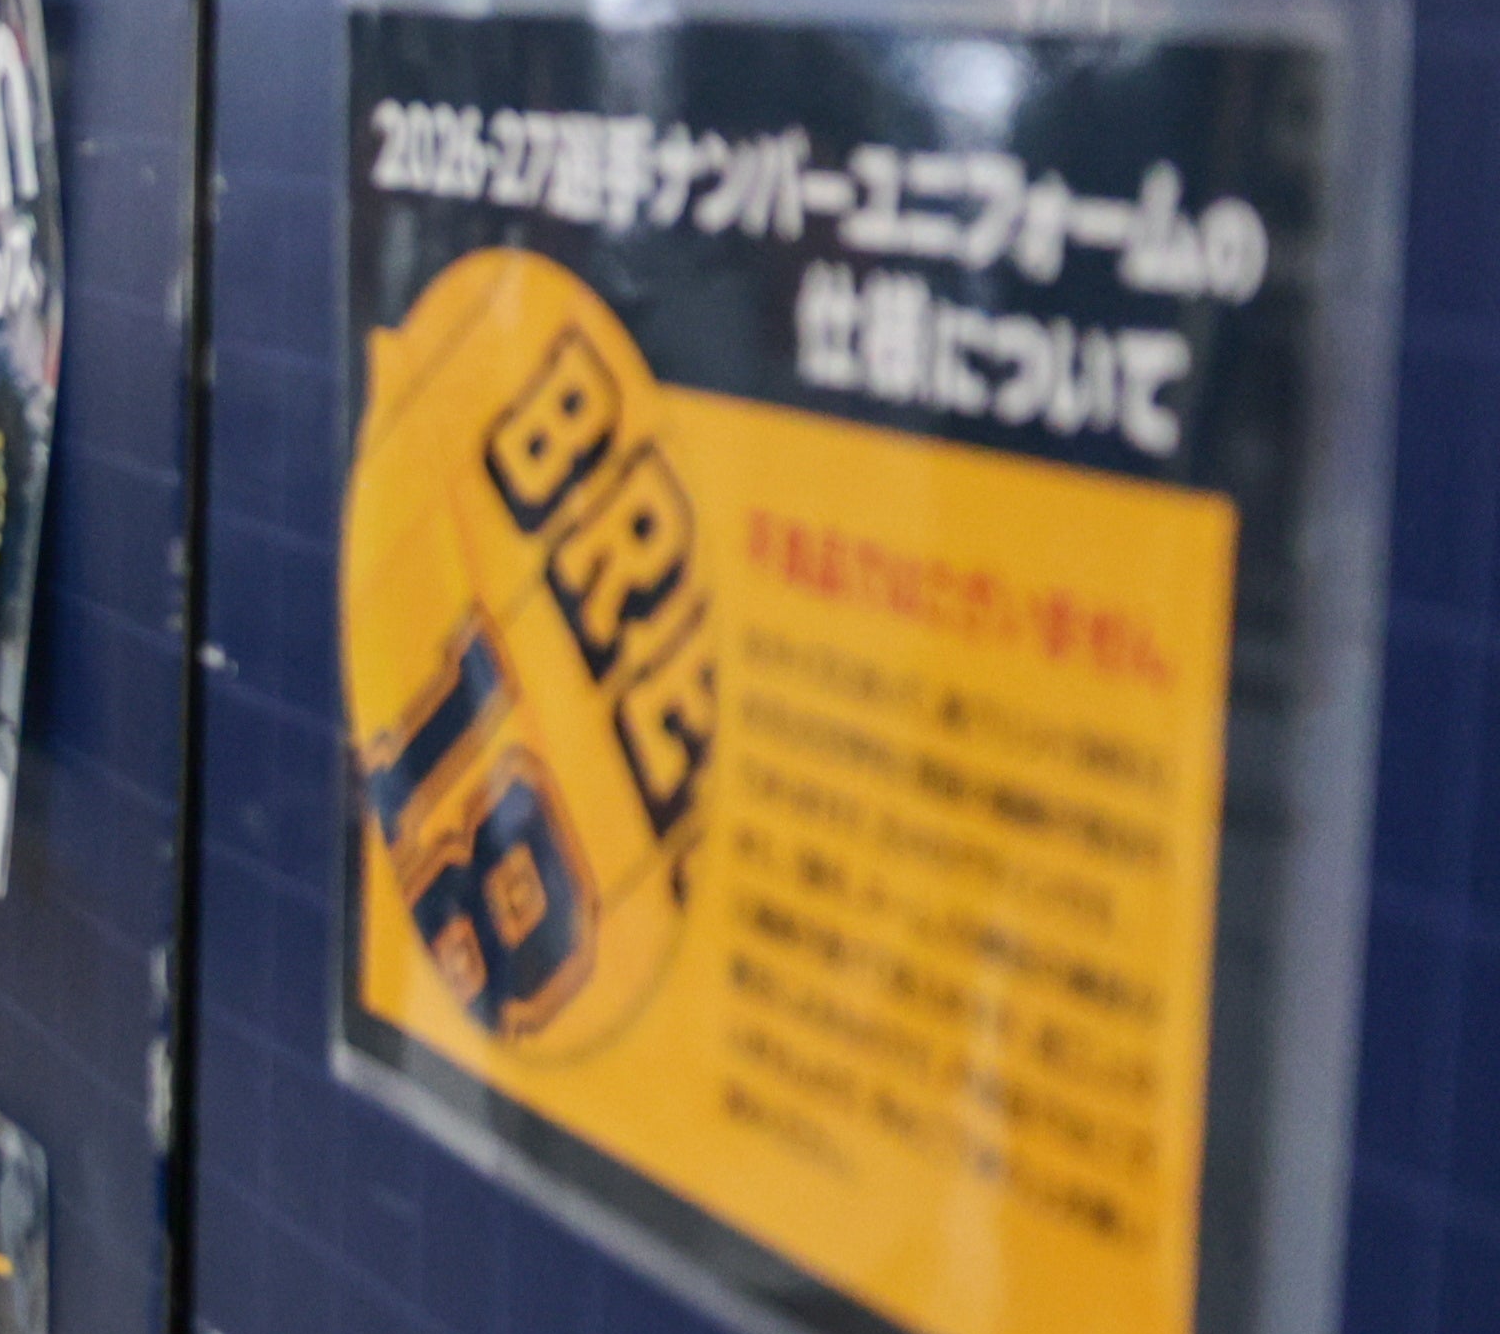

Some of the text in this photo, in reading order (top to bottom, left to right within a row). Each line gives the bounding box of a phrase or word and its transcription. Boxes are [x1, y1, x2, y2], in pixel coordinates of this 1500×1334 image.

[793, 261, 1190, 458] 仕様について
[483, 317, 717, 847] BRE
